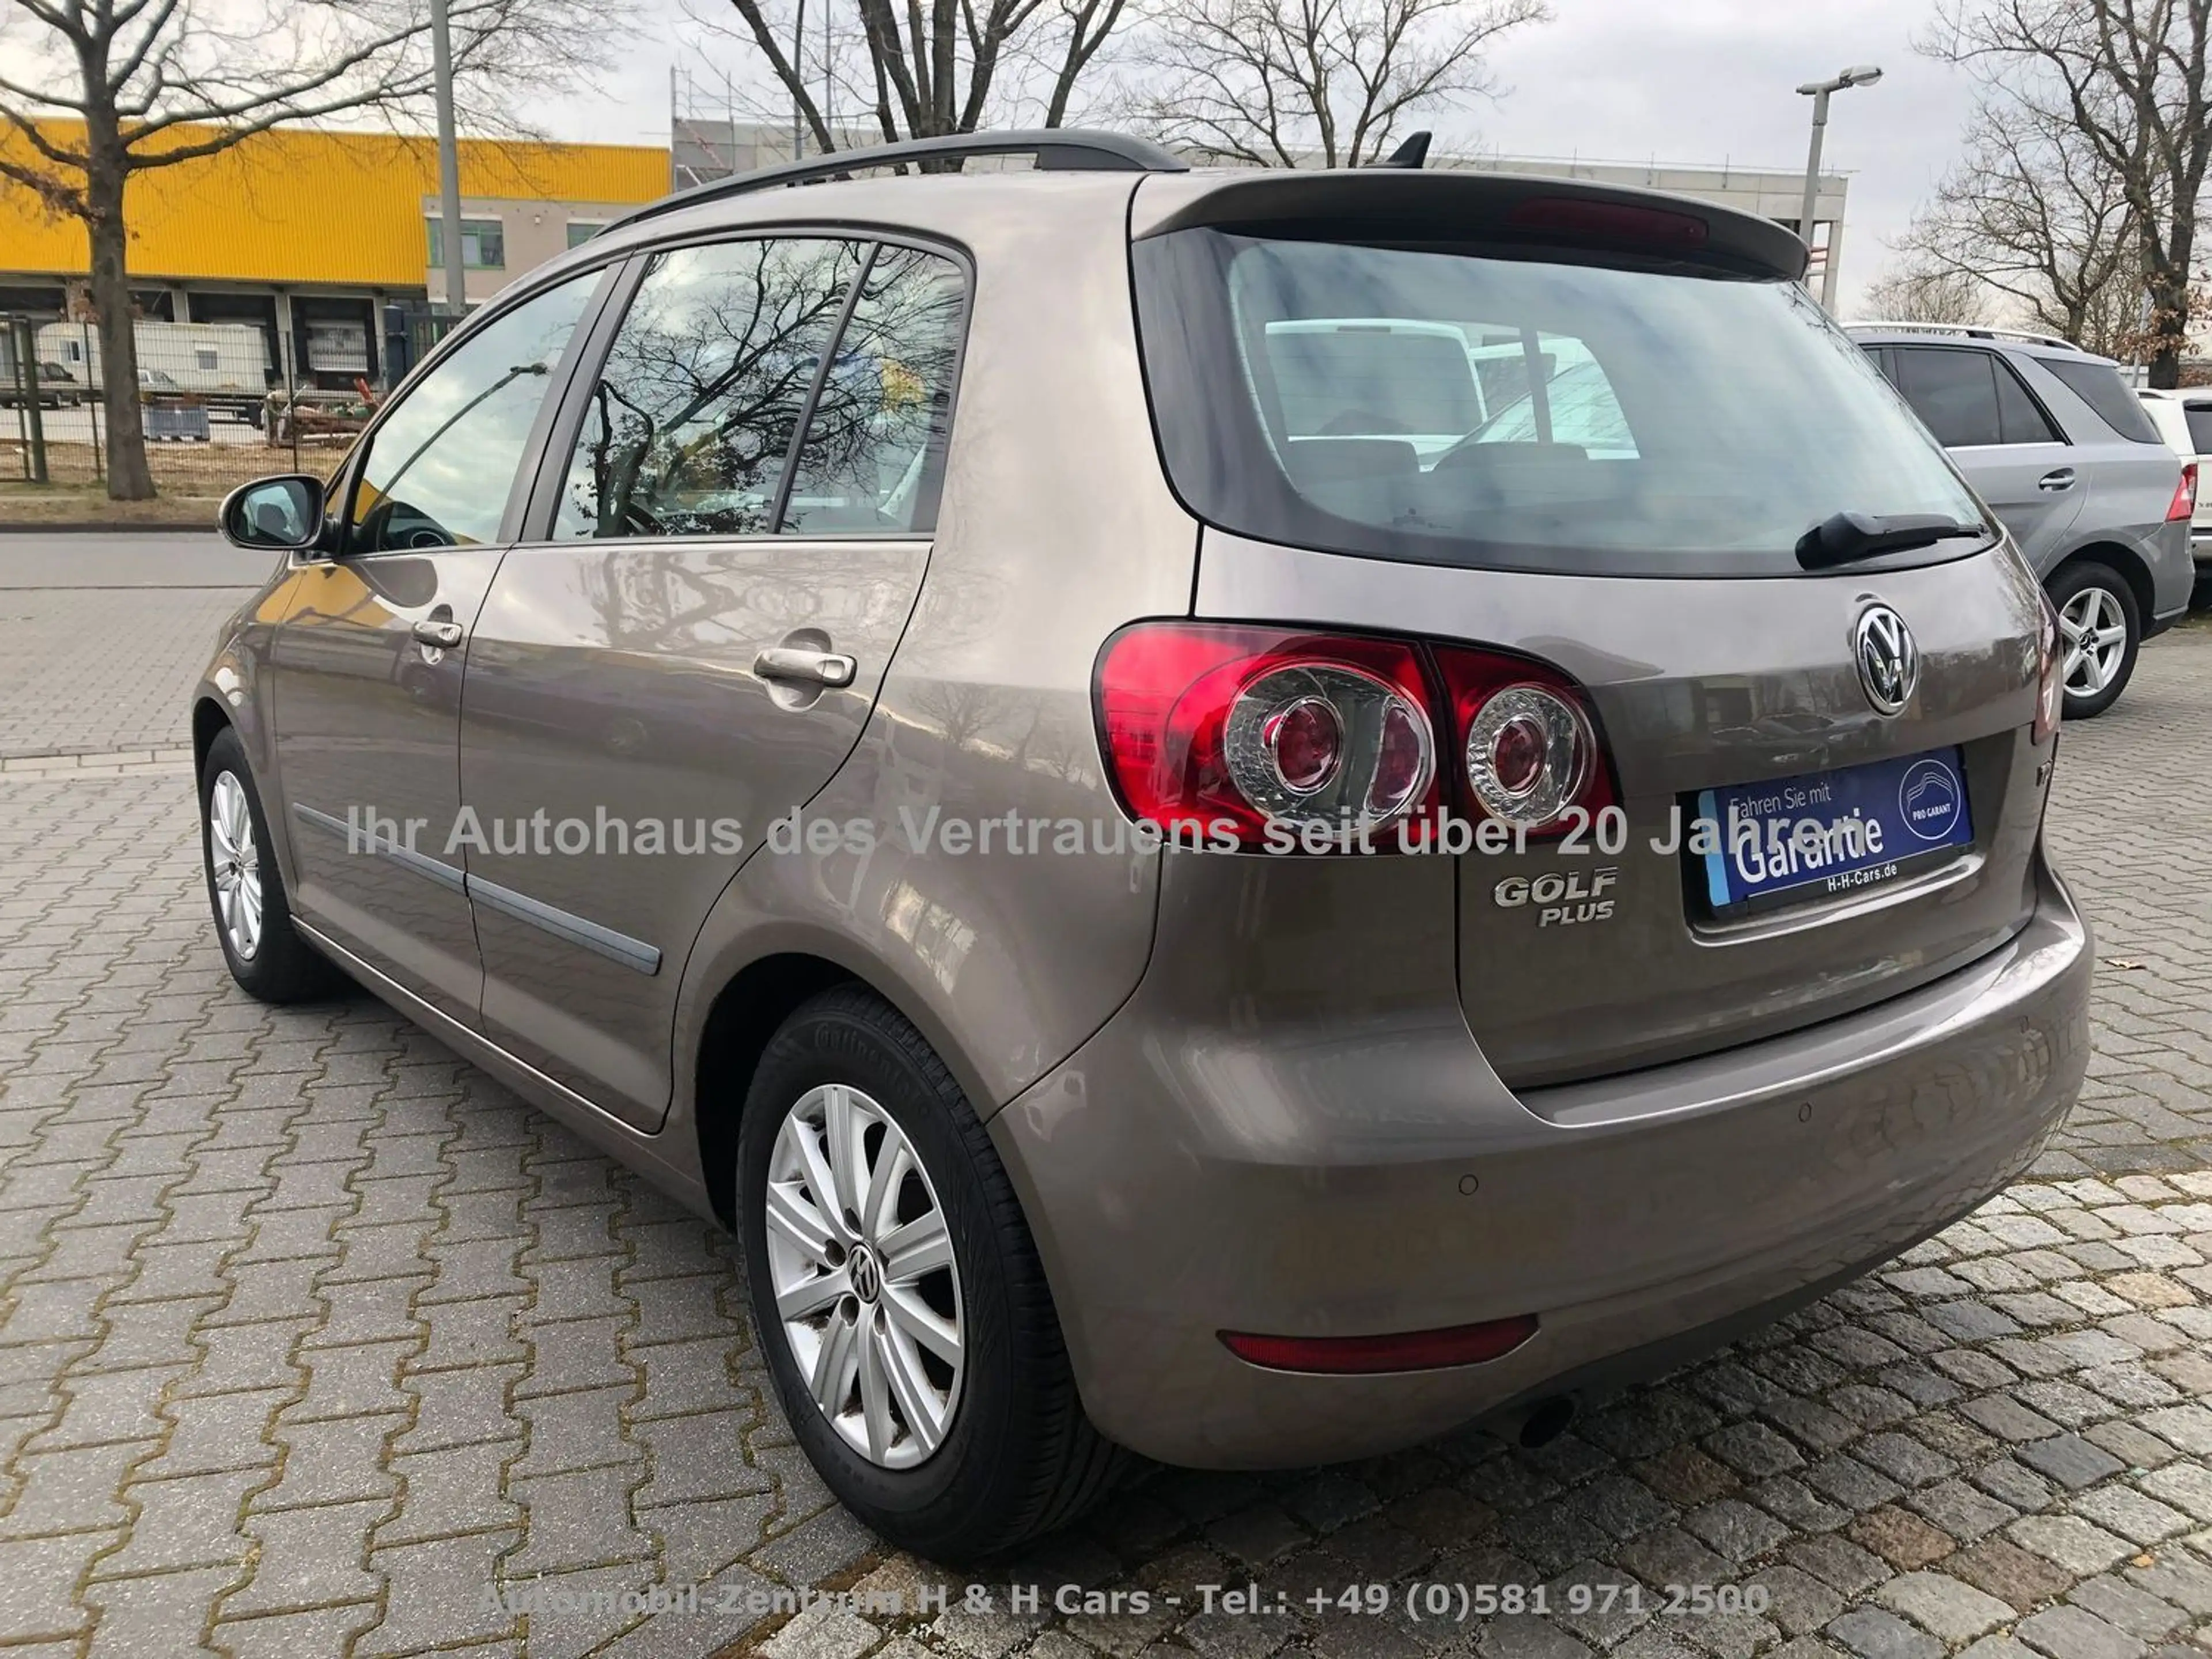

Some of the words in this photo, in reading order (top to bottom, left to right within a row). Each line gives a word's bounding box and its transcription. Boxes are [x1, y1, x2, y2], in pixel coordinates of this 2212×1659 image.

[1729, 797, 1782, 818] Fahren
[1784, 787, 1806, 809] Sie
[1809, 781, 1832, 805] mit
[1494, 866, 1619, 907] GOLF
[1828, 863, 1897, 892] H-H-Cars.de
[1539, 900, 1615, 927] PLUS
